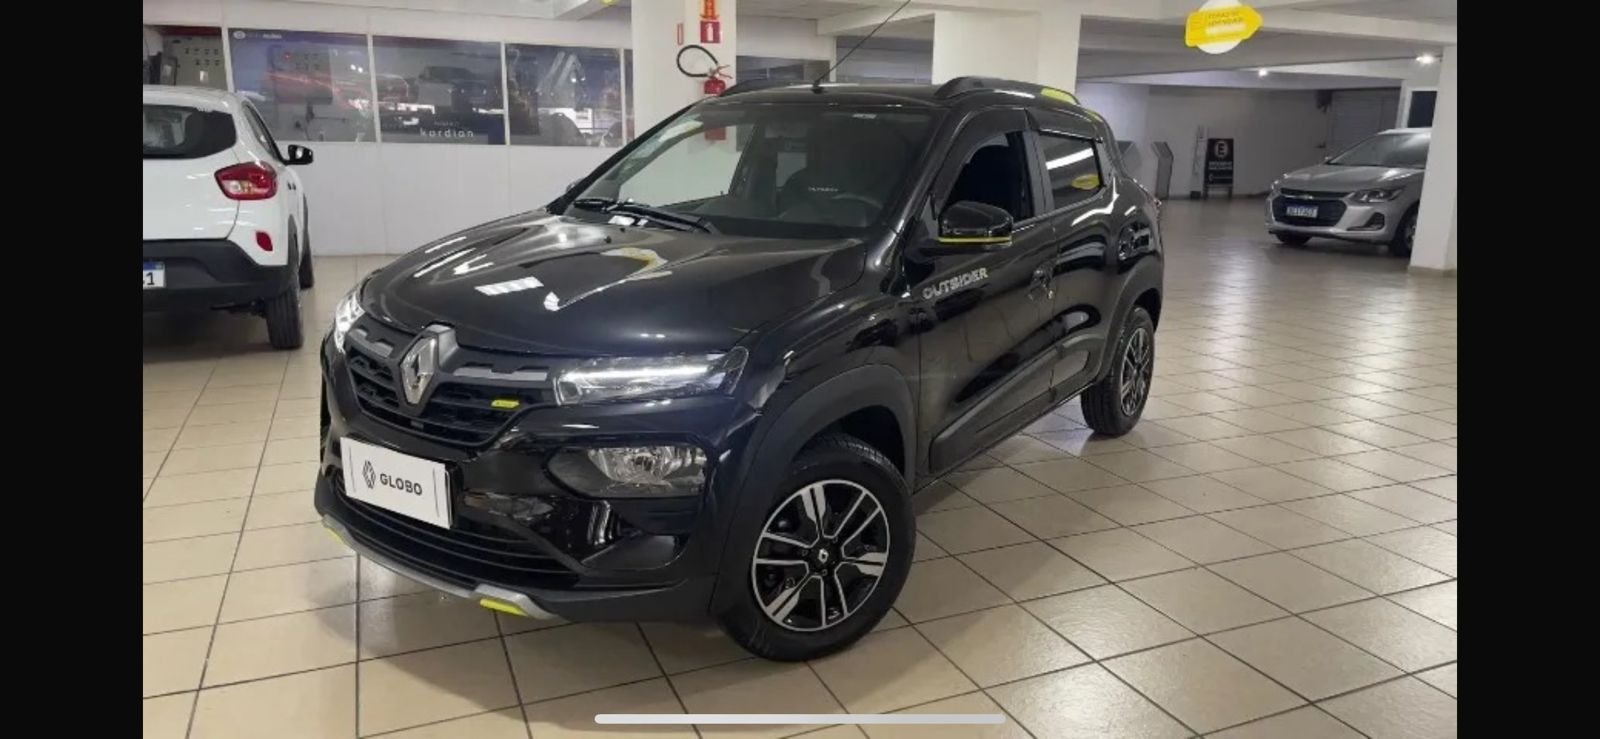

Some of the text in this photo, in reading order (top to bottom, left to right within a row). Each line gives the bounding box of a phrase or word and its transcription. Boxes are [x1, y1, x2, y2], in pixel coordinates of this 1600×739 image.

[143, 271, 156, 286] 1
[922, 267, 988, 300] OUTSIDER
[380, 473, 423, 496] GLOBO
